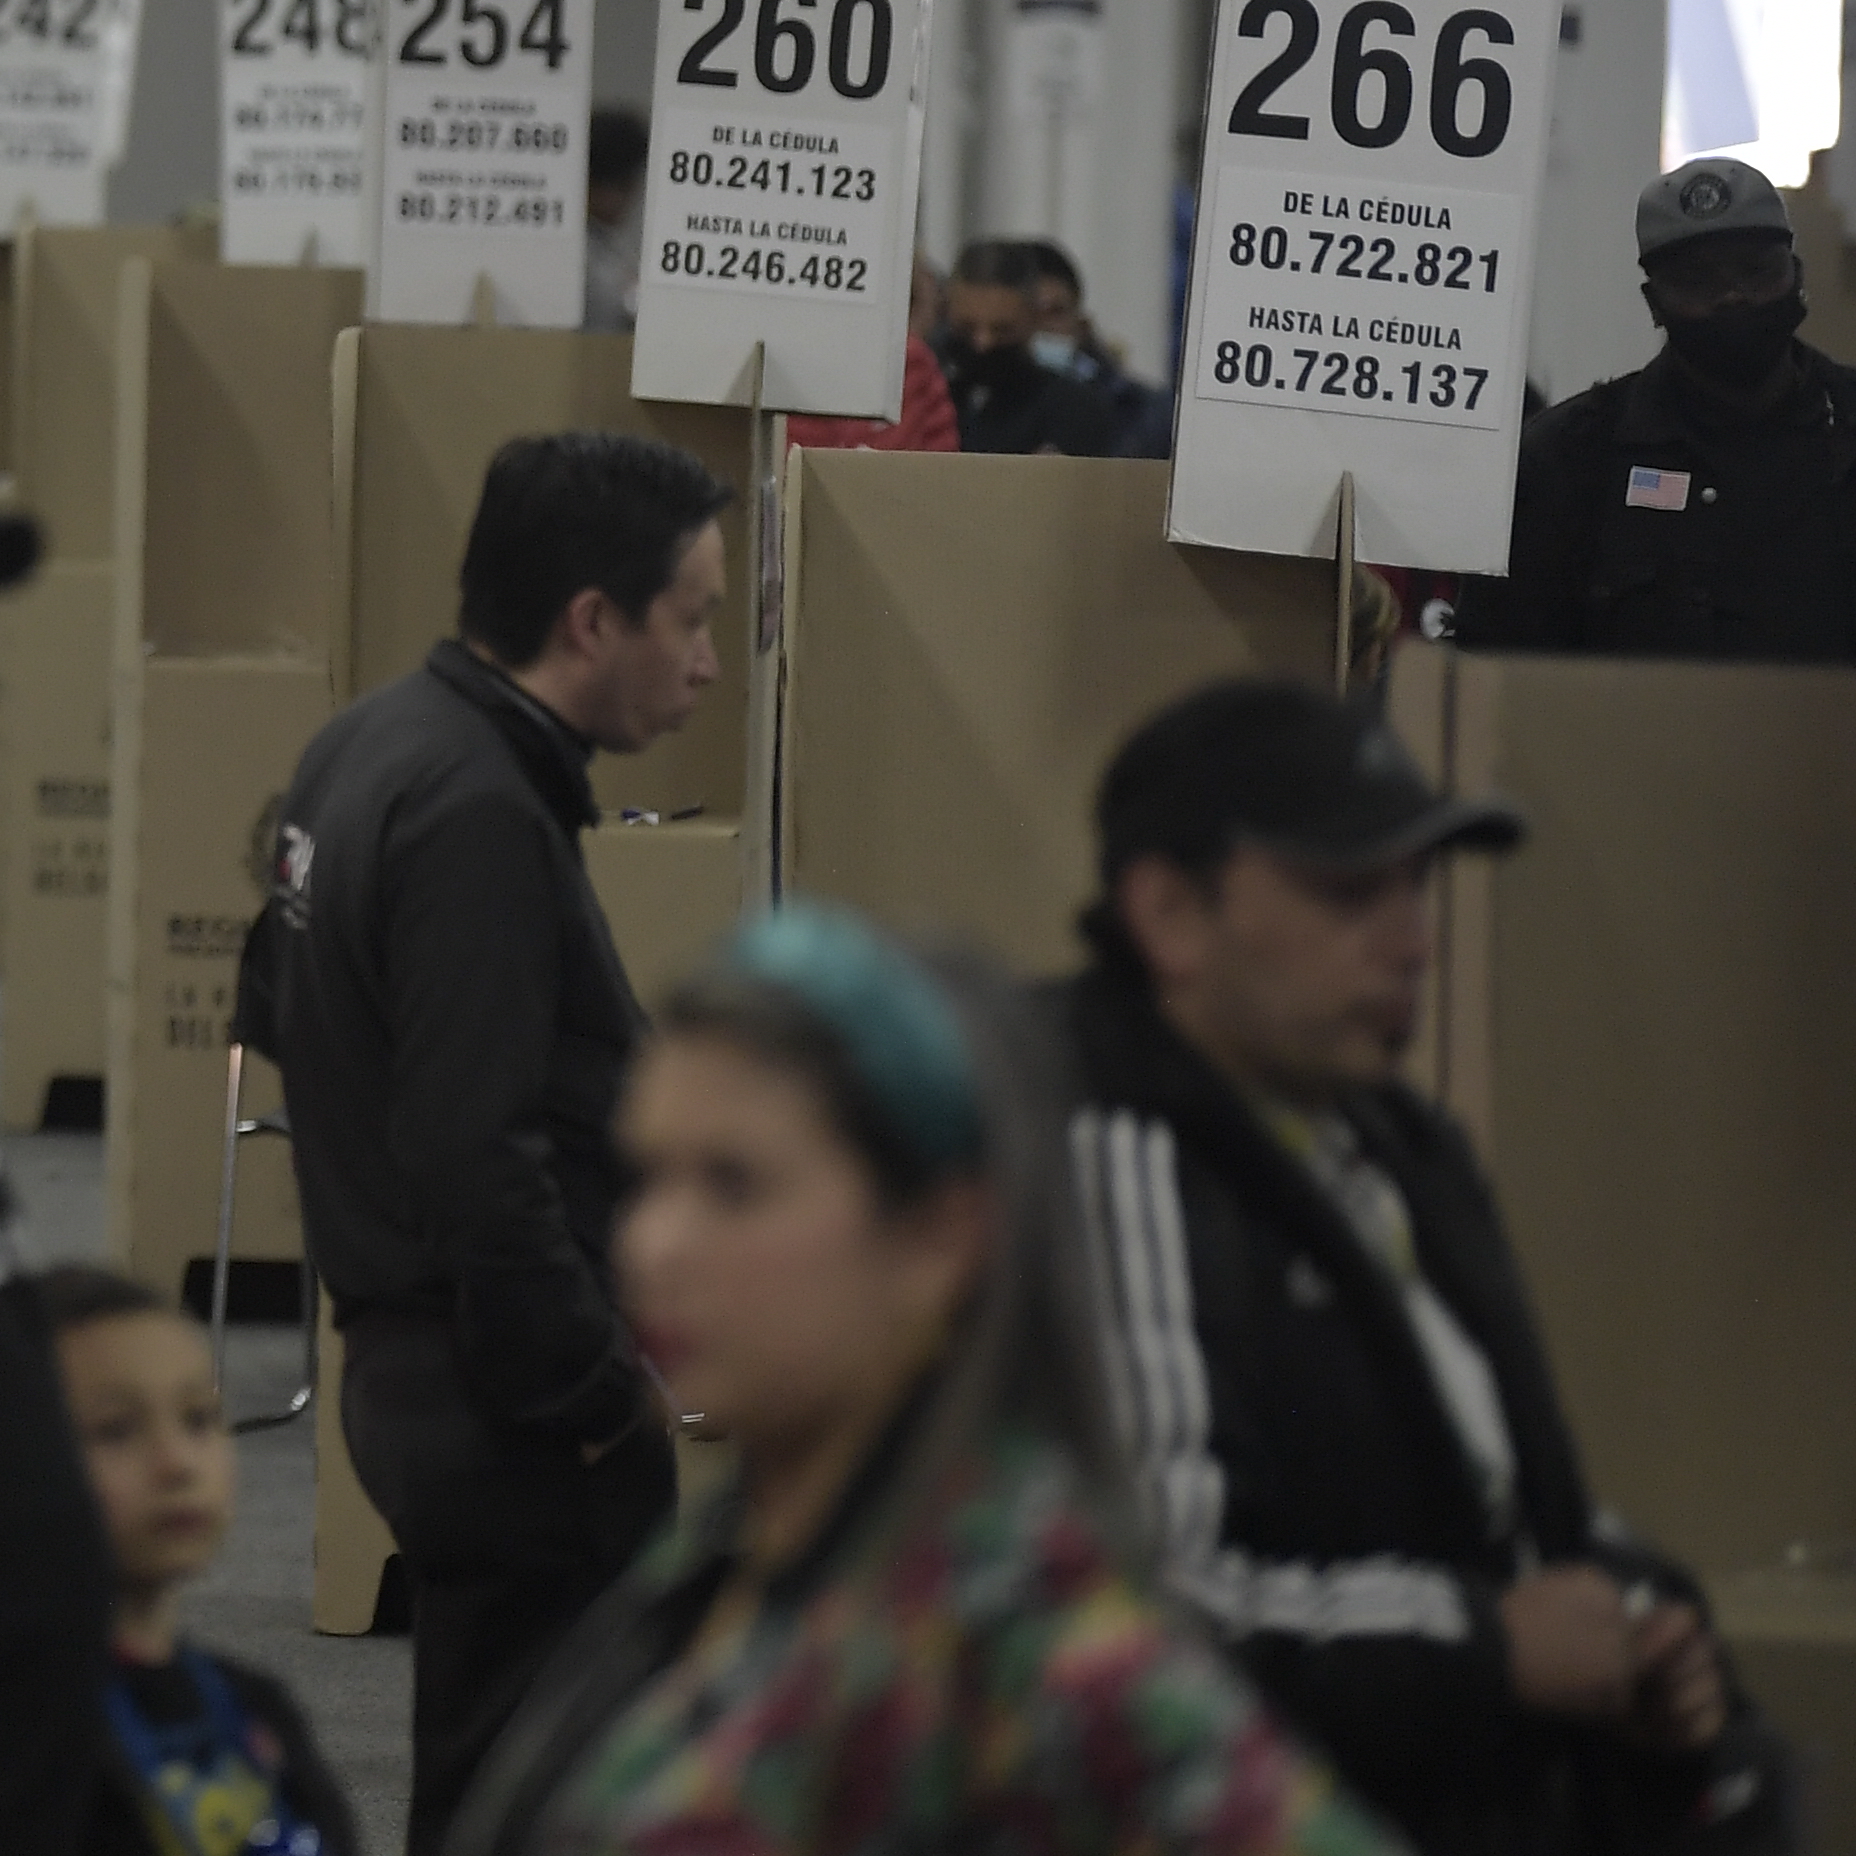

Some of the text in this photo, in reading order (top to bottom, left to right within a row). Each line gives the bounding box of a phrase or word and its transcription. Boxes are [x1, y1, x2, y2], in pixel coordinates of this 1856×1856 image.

[712, 125, 839, 154] DE LA CÉDULA
[670, 150, 877, 202] 80.241.123
[687, 214, 848, 246] HASTA LA CÉDULA
[1283, 190, 1452, 231] DE LA CÉDULA
[661, 240, 868, 292] 80.246.482
[1229, 222, 1500, 293] 80.722.821
[1249, 306, 1462, 351] HASTA LA CÉDULA
[1214, 340, 1489, 411] 80.728.137
